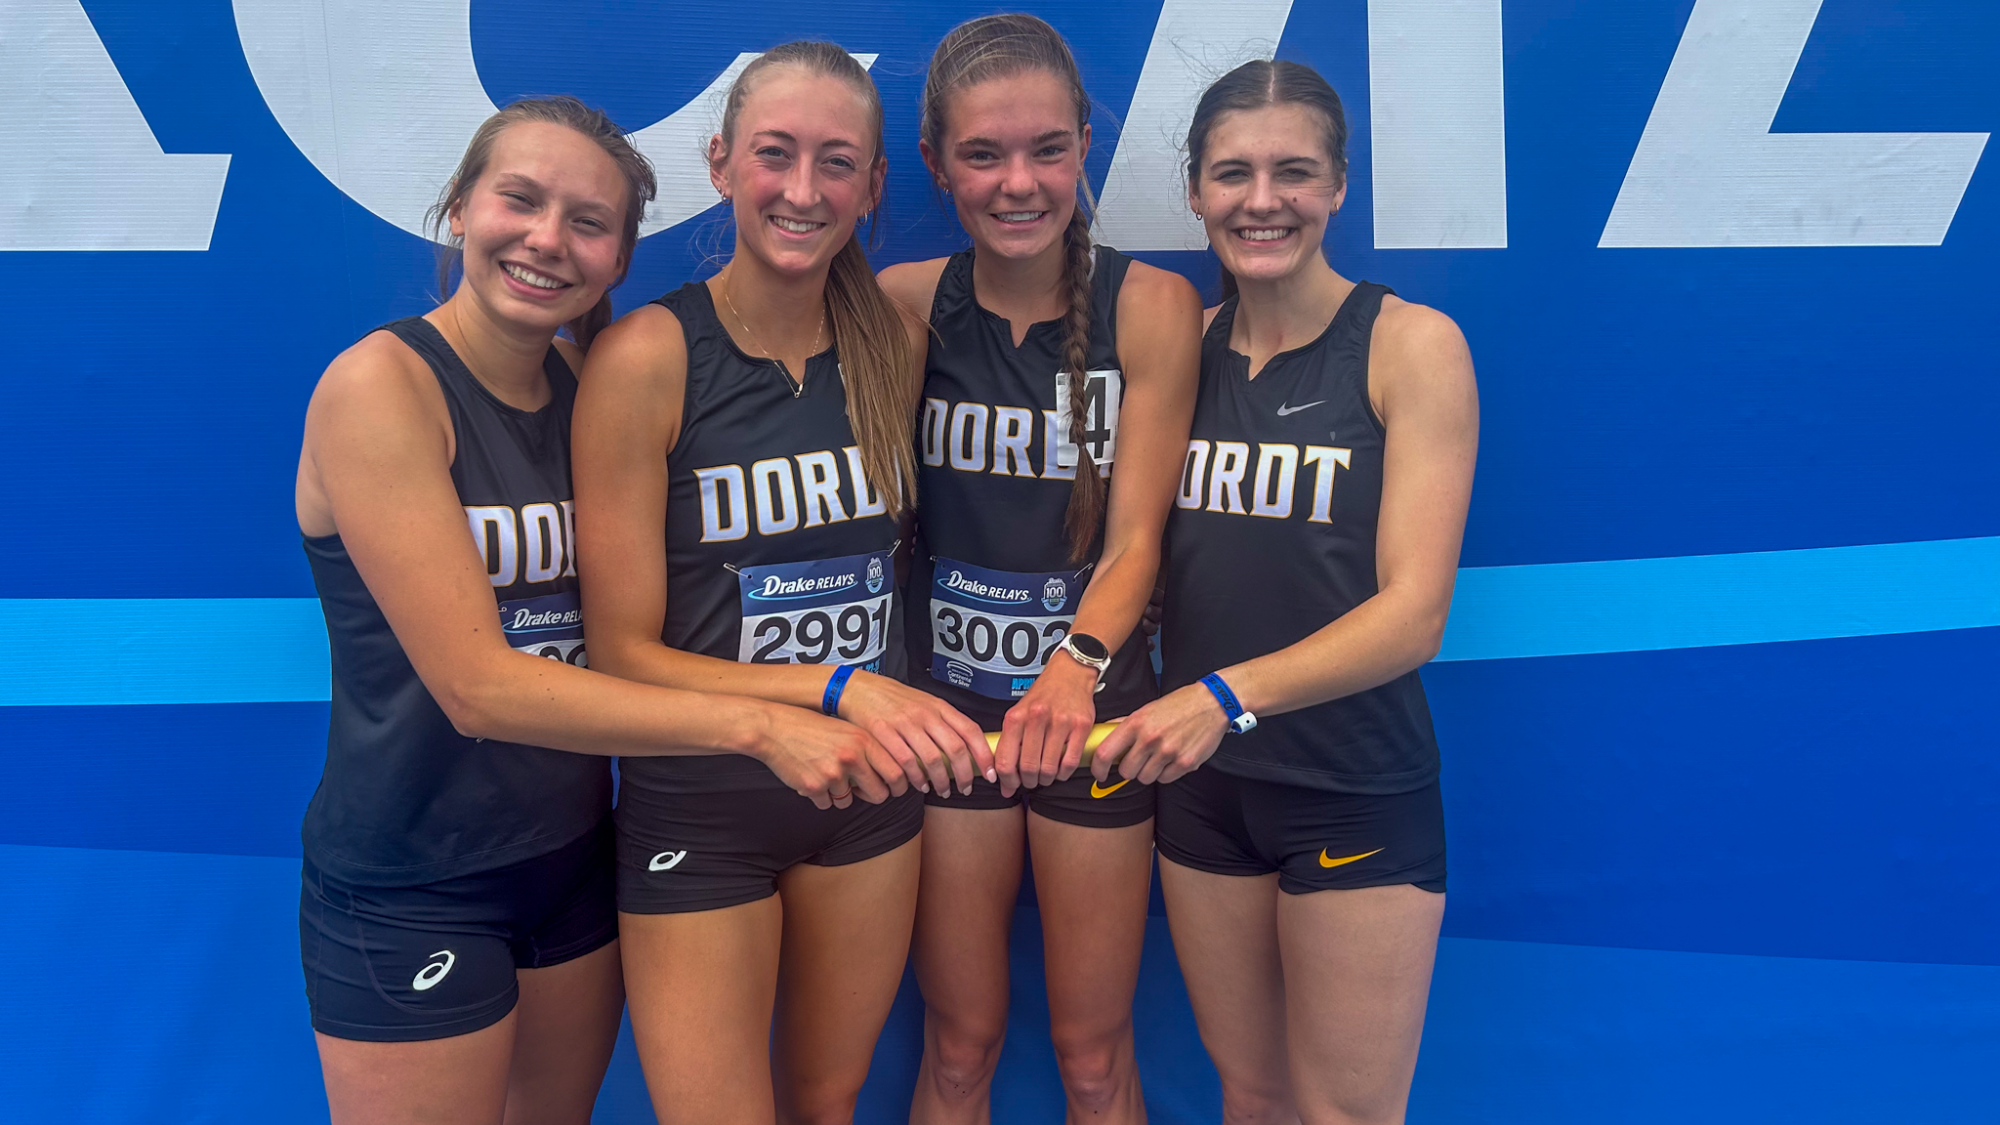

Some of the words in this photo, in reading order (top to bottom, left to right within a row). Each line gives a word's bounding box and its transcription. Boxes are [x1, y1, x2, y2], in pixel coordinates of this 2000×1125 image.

[1068, 376, 1110, 459] 4
[463, 500, 577, 587] DO
[762, 575, 815, 596] Drake
[816, 573, 855, 590] RELAYS
[947, 570, 988, 595] Drake
[988, 586, 1029, 601] RELAYS
[1046, 586, 1063, 598] 100
[512, 608, 562, 629] Drake
[751, 598, 888, 664] 2991
[937, 607, 1072, 667] 3002
